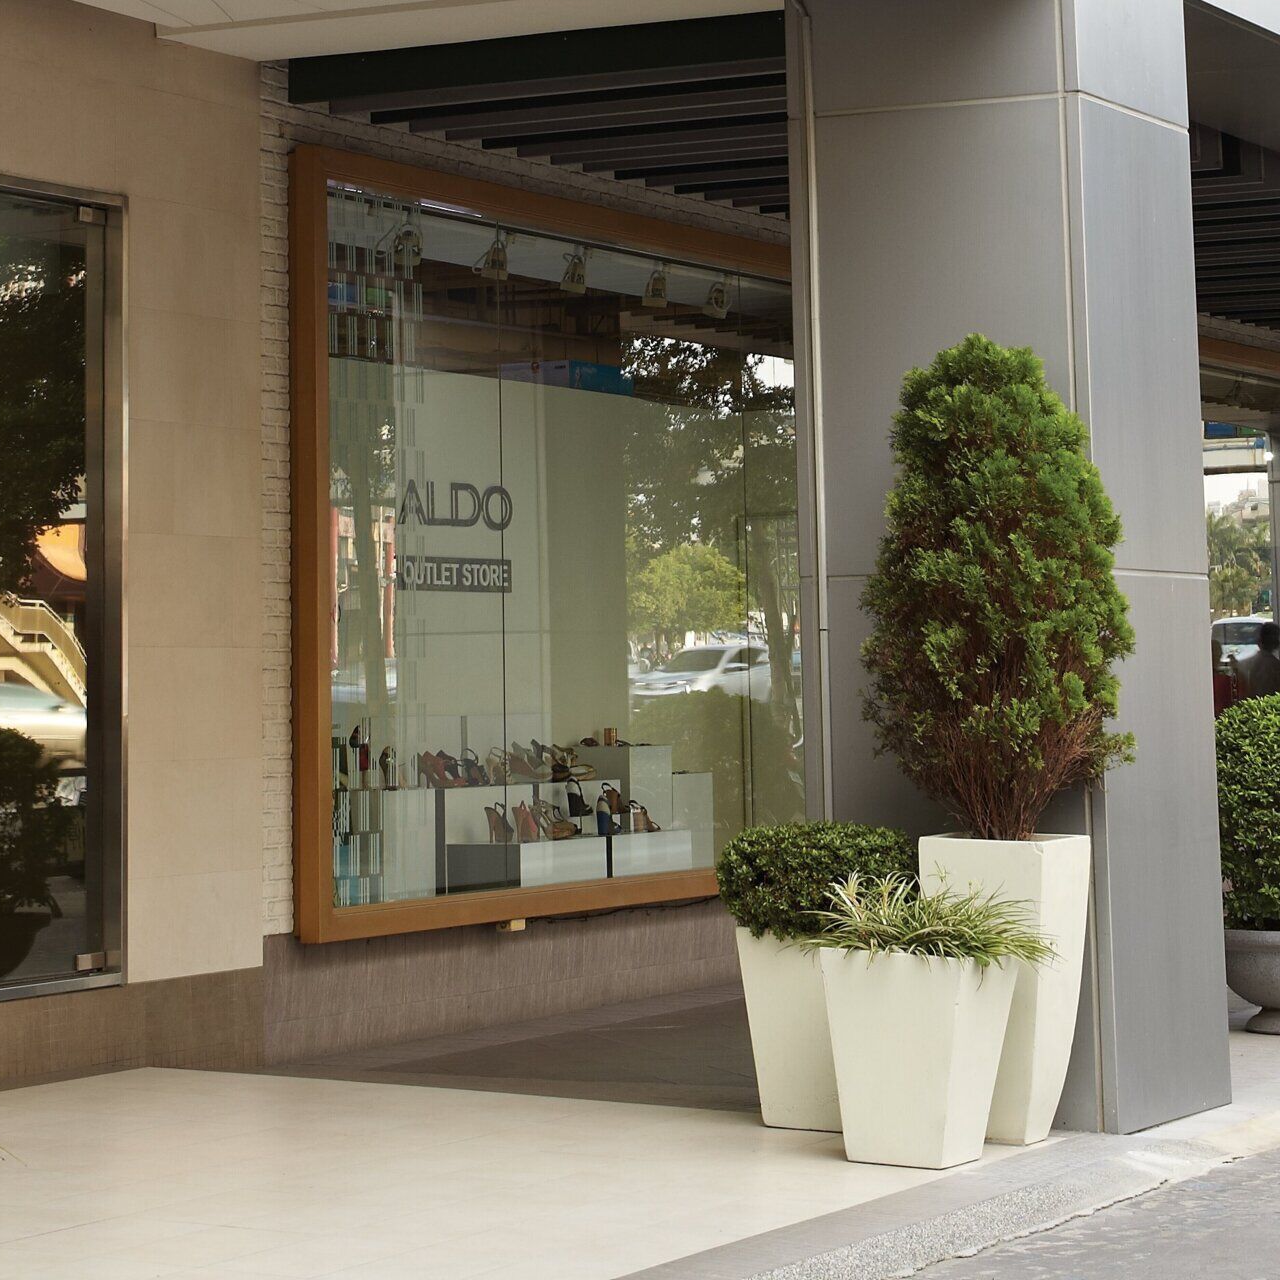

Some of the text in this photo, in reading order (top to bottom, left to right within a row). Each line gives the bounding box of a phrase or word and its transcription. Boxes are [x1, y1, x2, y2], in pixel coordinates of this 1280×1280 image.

[398, 479, 513, 531] ALDO
[404, 560, 509, 588] OUTLET STORE
